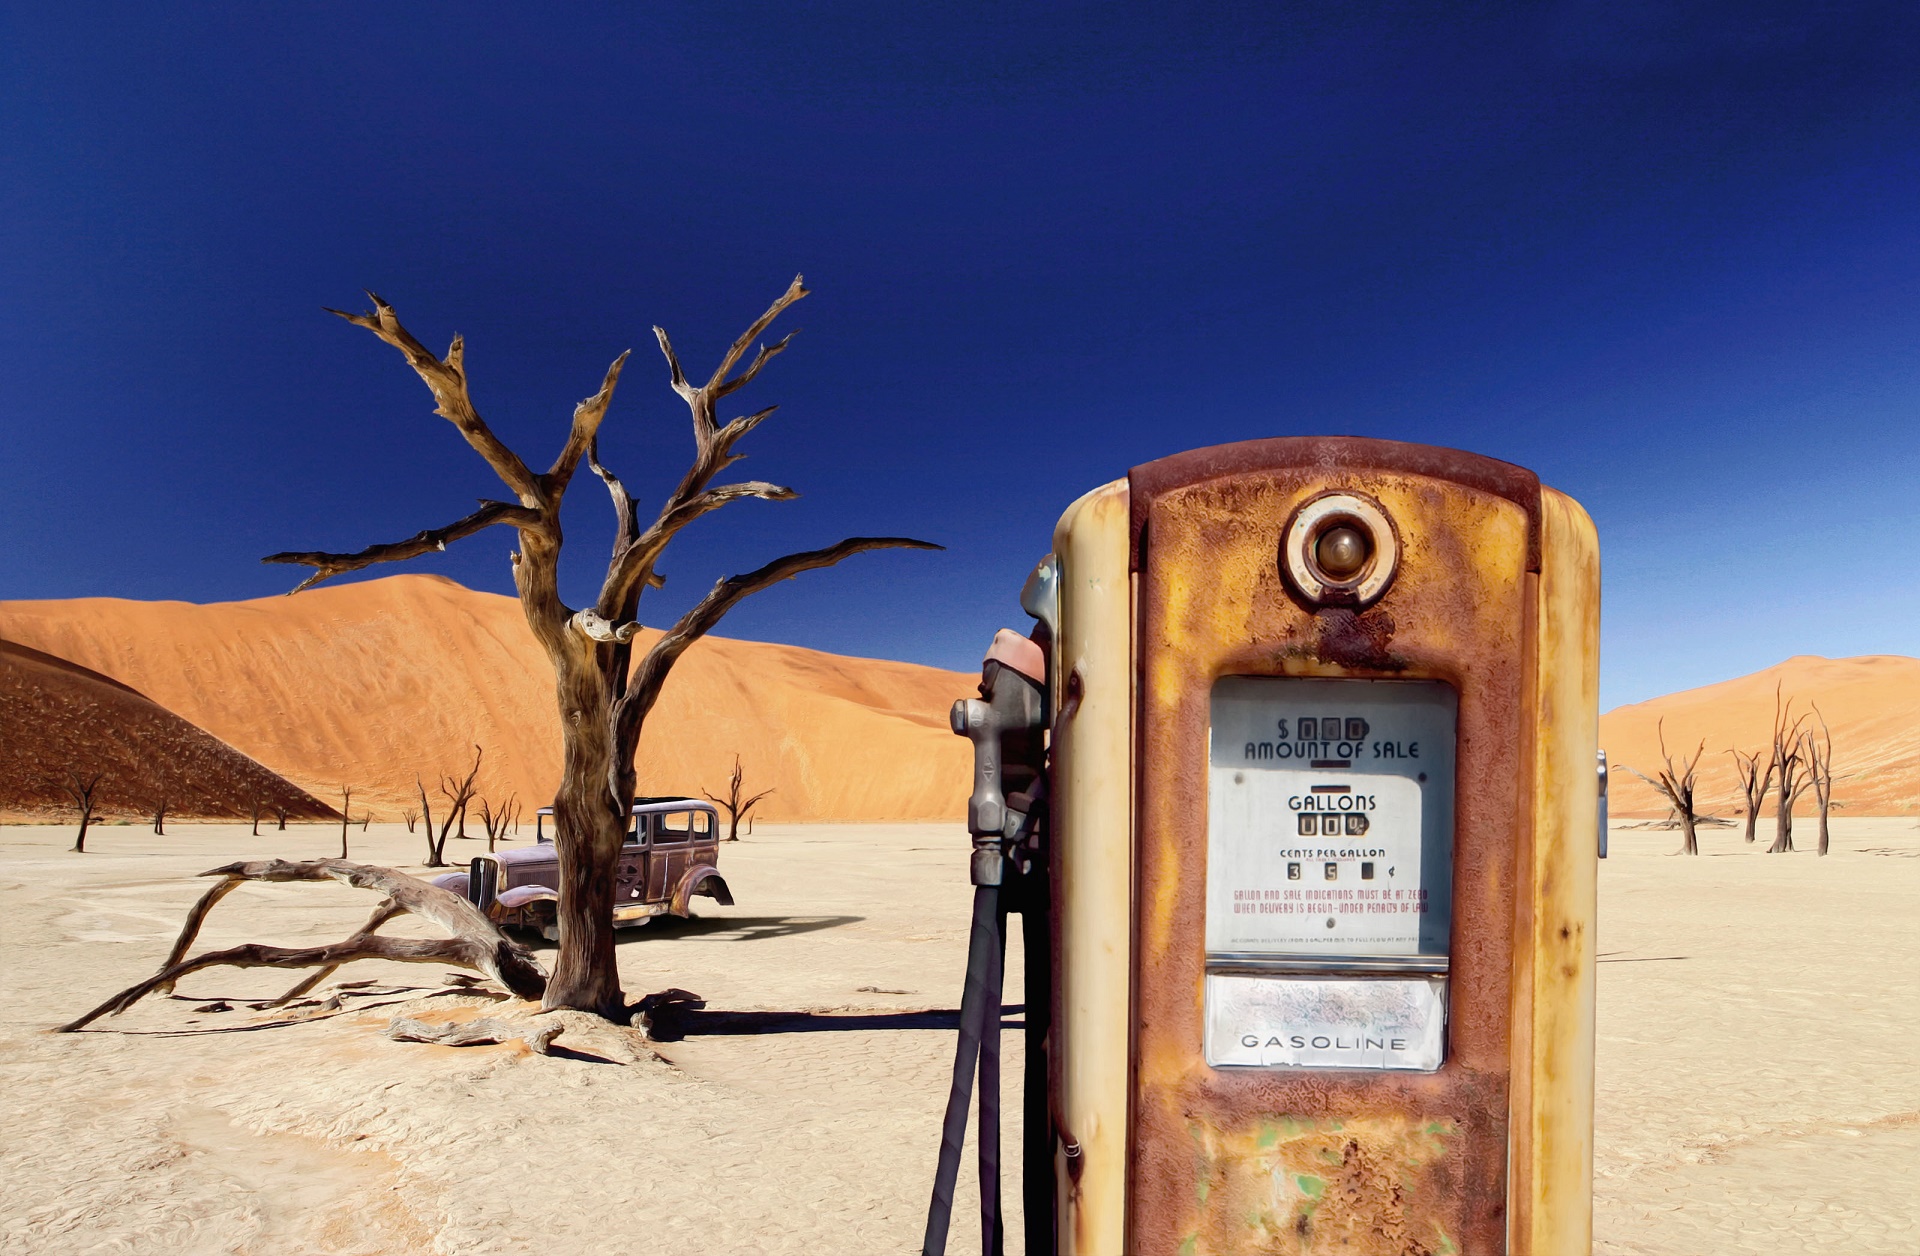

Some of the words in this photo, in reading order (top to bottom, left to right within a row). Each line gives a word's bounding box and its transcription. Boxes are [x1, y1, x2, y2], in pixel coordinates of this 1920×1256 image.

[1278, 718, 1289, 740] $
[1245, 741, 1330, 760] AMOUNT
[1336, 741, 1364, 759] OF
[1373, 741, 1420, 759] SALE
[1288, 795, 1376, 811] GALLONS
[1280, 849, 1313, 858] CENTS
[1317, 849, 1337, 858] PER
[1340, 849, 1386, 858] GALLON
[1289, 865, 1299, 880] 3
[1327, 866, 1336, 880] 5
[1234, 889, 1261, 900] GALLON
[1264, 889, 1280, 900] AND
[1284, 889, 1301, 900] SALE
[1305, 889, 1353, 900] INDICATIONS
[1357, 889, 1379, 900] MUST
[1382, 889, 1392, 900] BE
[1395, 889, 1404, 900] AT
[1408, 889, 1428, 900] ZERO
[1234, 902, 1256, 914] WHEN
[1259, 902, 1294, 914] DELIVERY
[1296, 902, 1304, 914] IS
[1367, 902, 1398, 914] PENALTY
[1401, 902, 1409, 914] OF
[1412, 902, 1429, 914] LAW
[1241, 1034, 1407, 1051] GASOLINE
